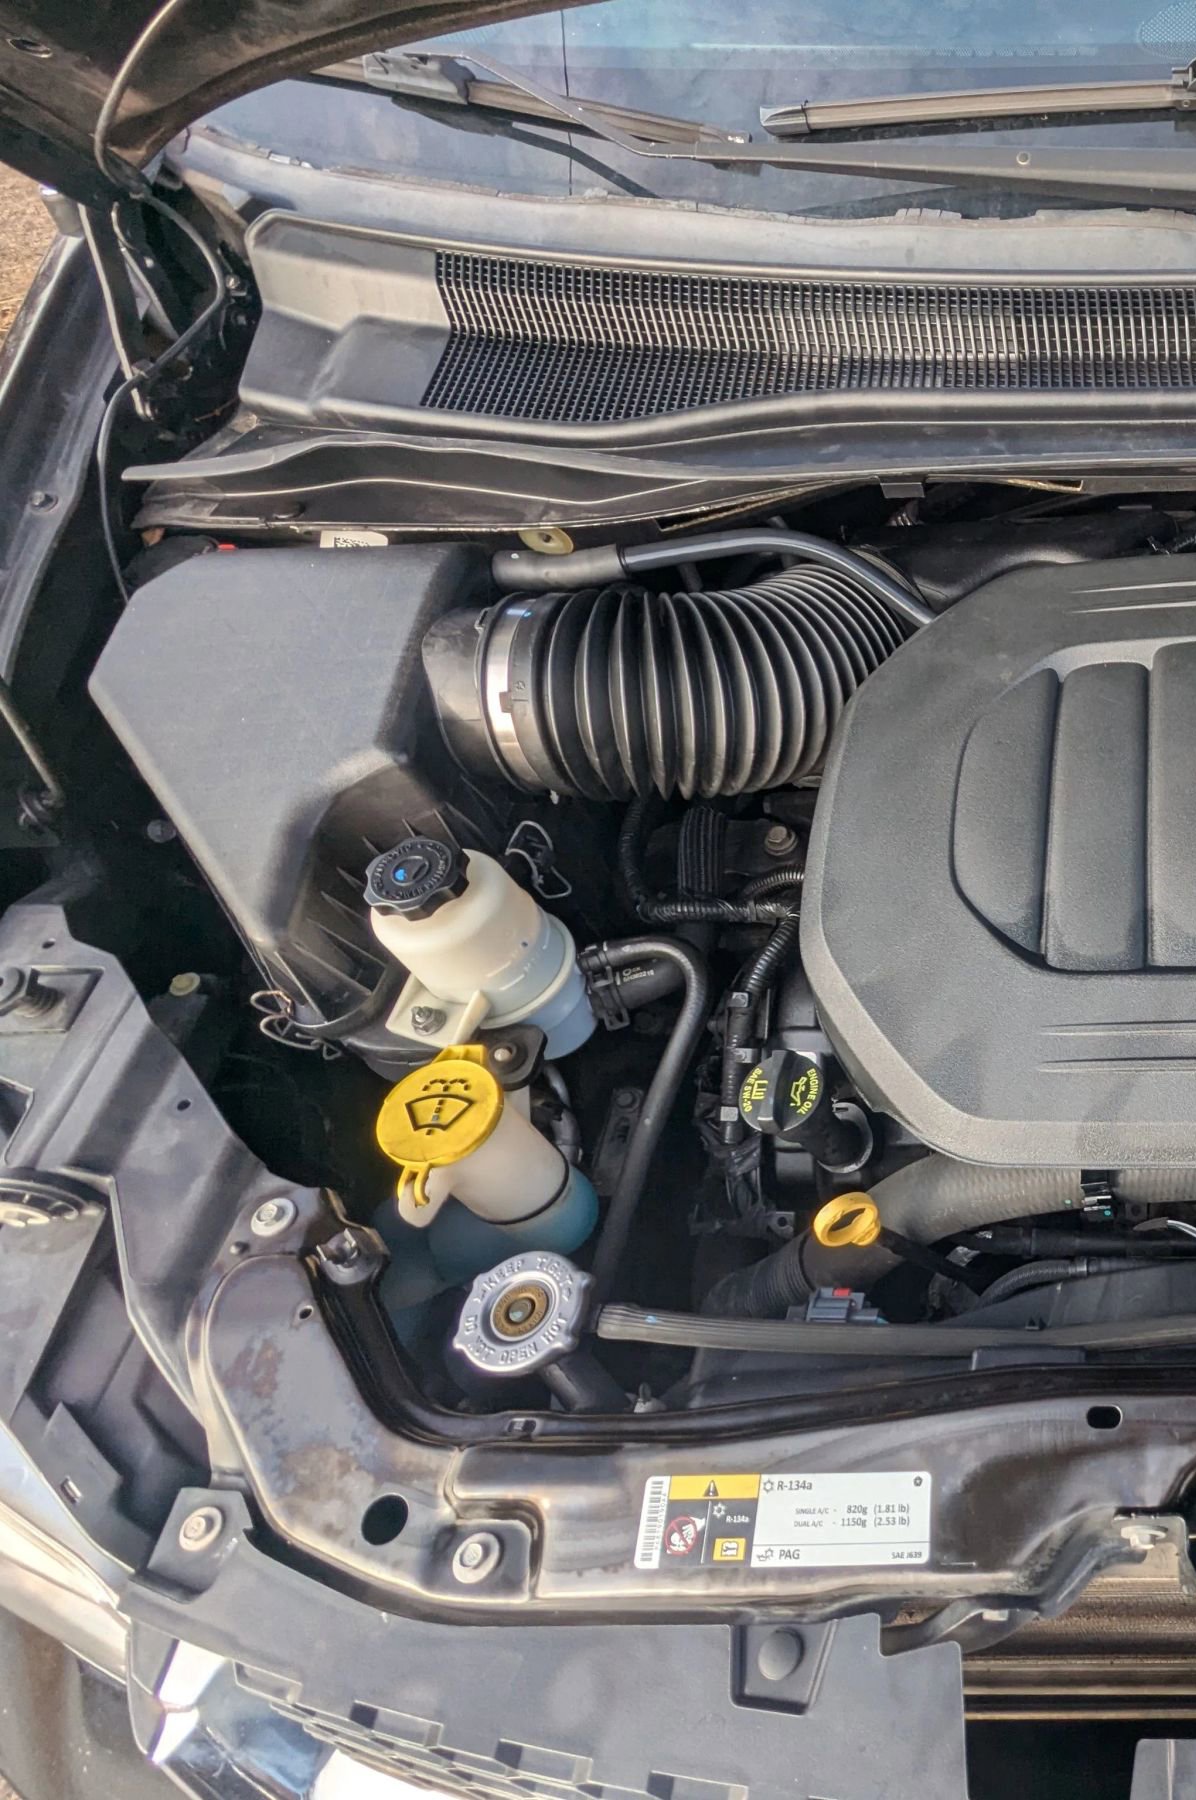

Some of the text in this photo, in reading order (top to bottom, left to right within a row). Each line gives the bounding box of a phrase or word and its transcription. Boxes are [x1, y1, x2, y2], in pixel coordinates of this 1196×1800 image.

[746, 1068, 763, 1085] SAE
[796, 1068, 819, 1115] ENGINE OIL
[498, 1342, 538, 1365] OPEN
[540, 1312, 568, 1345] HOT
[776, 1480, 813, 1491] R-134a
[795, 1507, 816, 1515] SINGLE
[817, 1506, 829, 1515] A/C
[846, 1504, 868, 1515] 820g
[874, 1504, 897, 1515] (1.81
[898, 1504, 910, 1514] lb)
[726, 1515, 750, 1524] R-134a
[794, 1519, 810, 1528] DUAL
[810, 1519, 823, 1528] A/C
[840, 1517, 867, 1528] 1150g
[874, 1516, 897, 1527] (2.53
[898, 1516, 910, 1527] lb)
[779, 1549, 800, 1560] PAG
[892, 1551, 922, 1560] SAE J639
